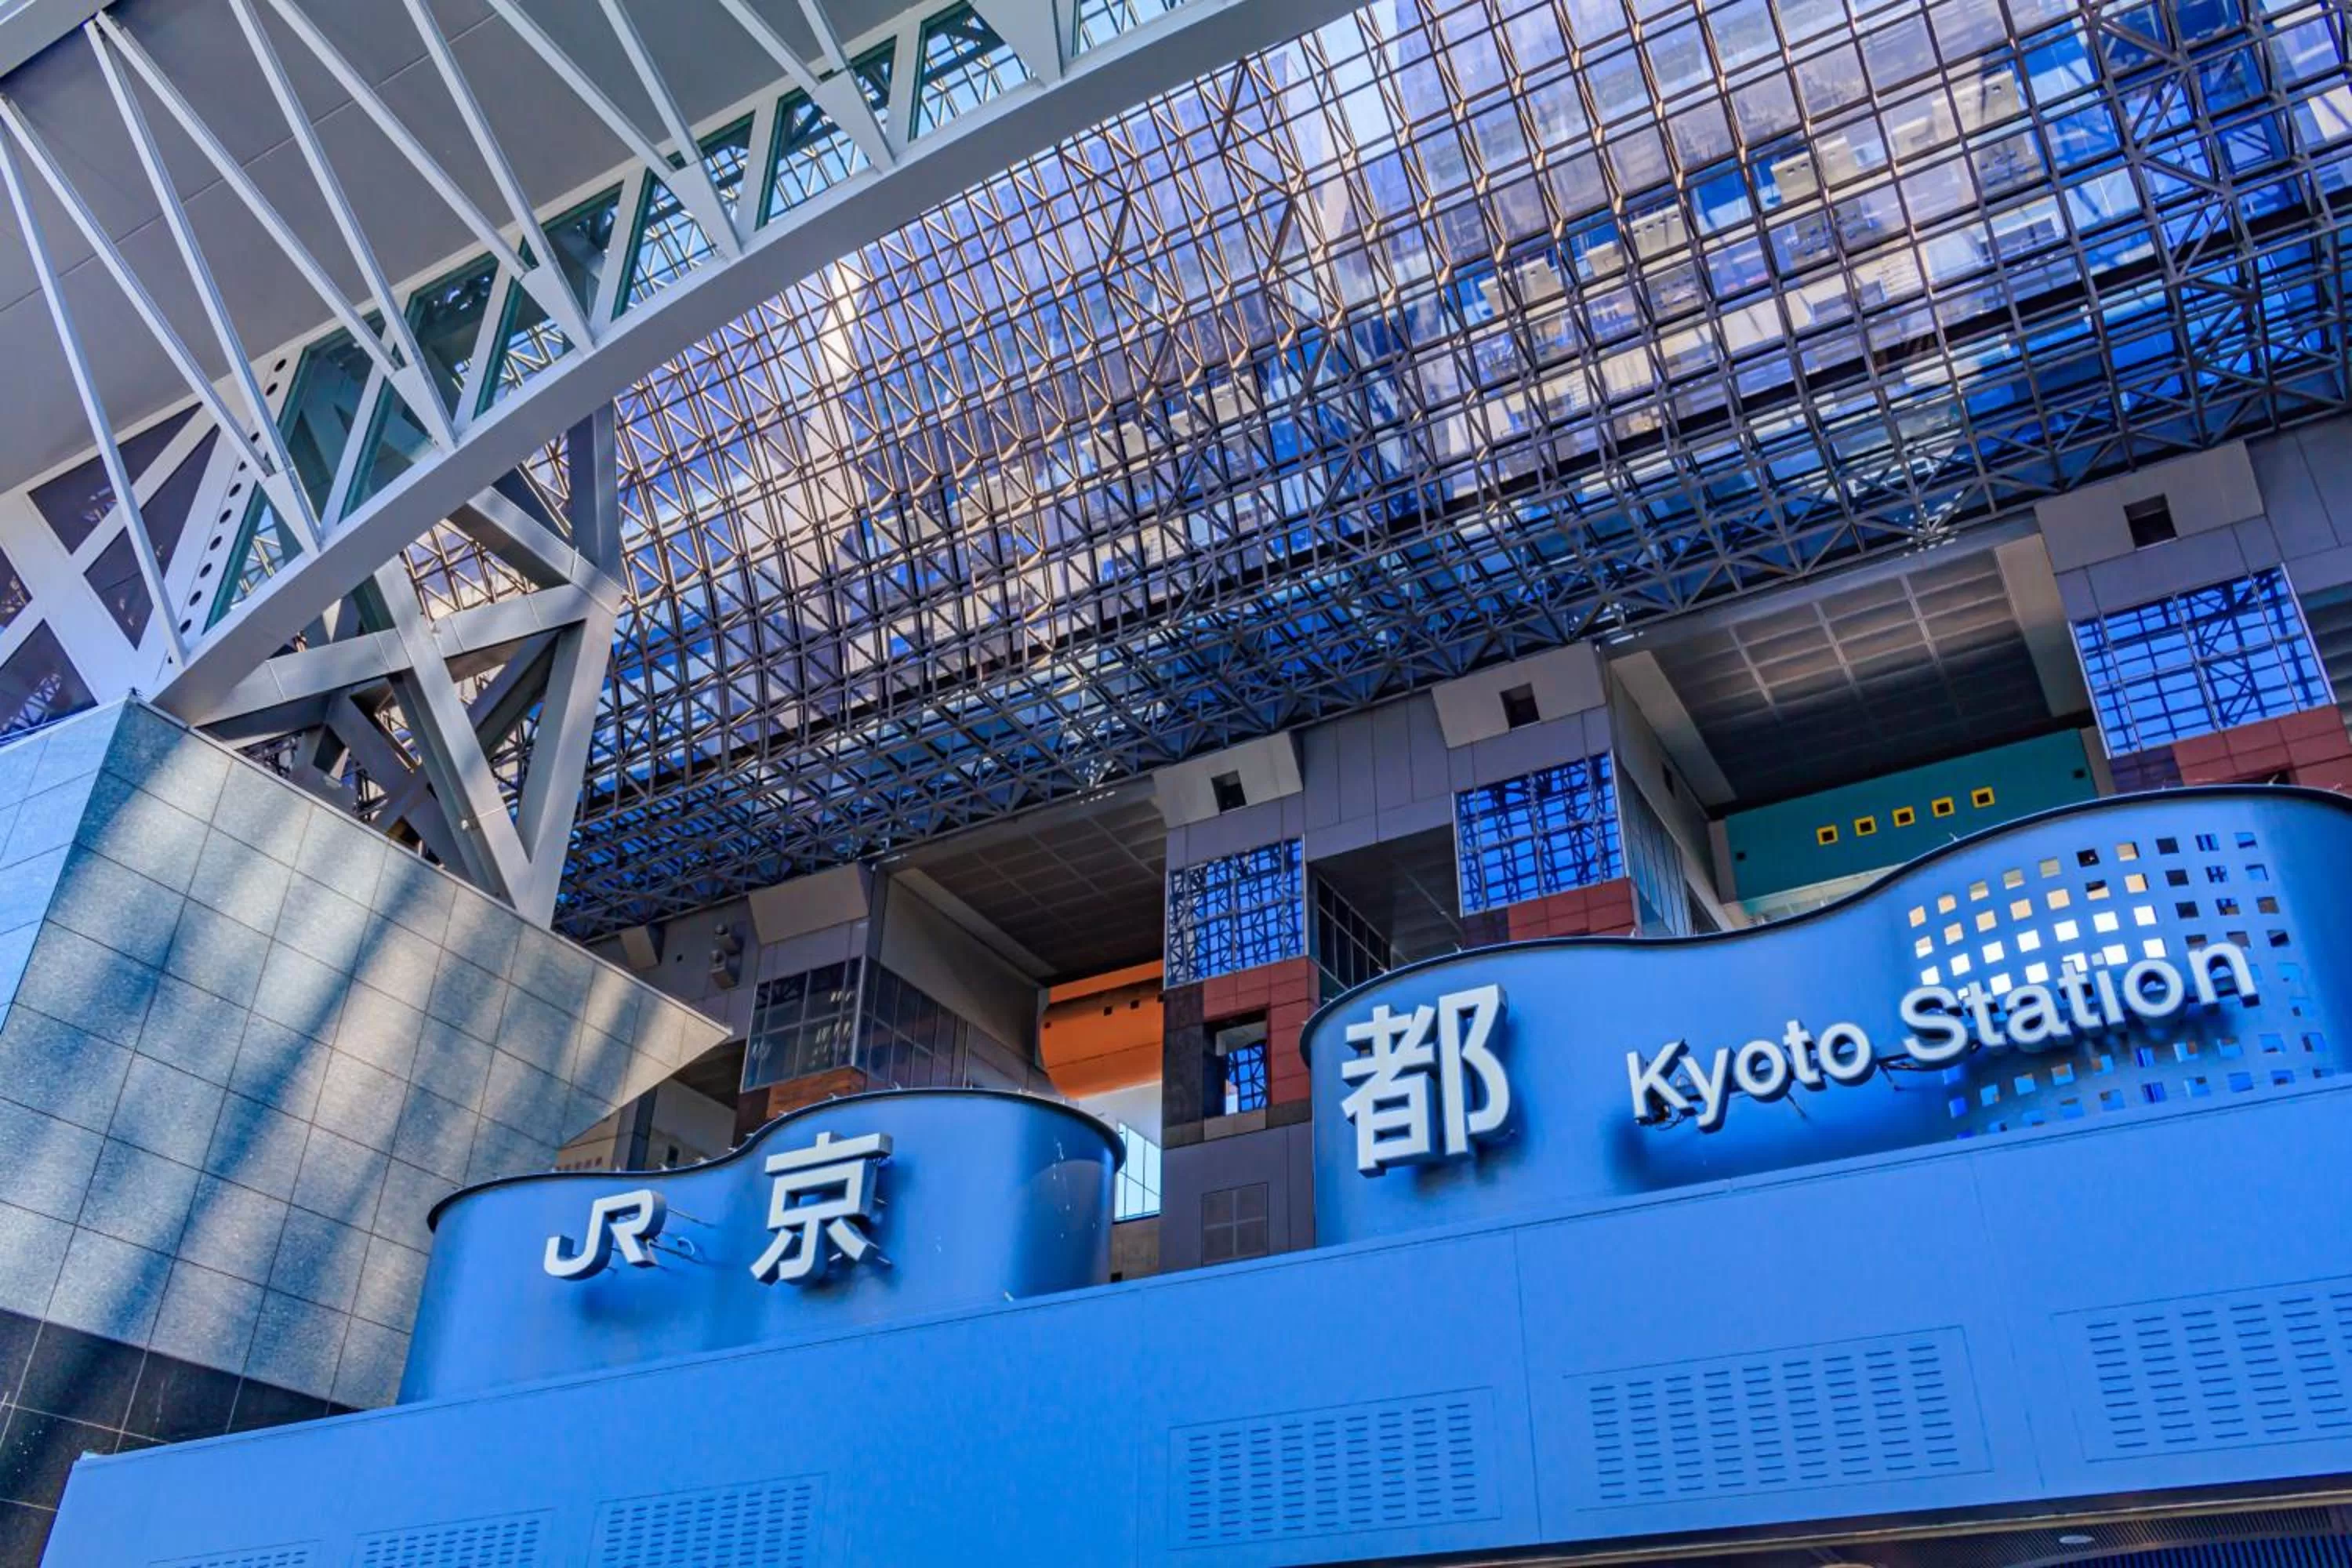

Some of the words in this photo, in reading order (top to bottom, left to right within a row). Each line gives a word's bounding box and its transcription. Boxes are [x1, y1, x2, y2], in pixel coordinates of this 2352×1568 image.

[1341, 984, 1510, 1176] 都
[1626, 1019, 1872, 1132] Kyoto
[1900, 942, 2258, 1065] Station
[543, 1189, 663, 1279] JR
[750, 1132, 891, 1283] 京
